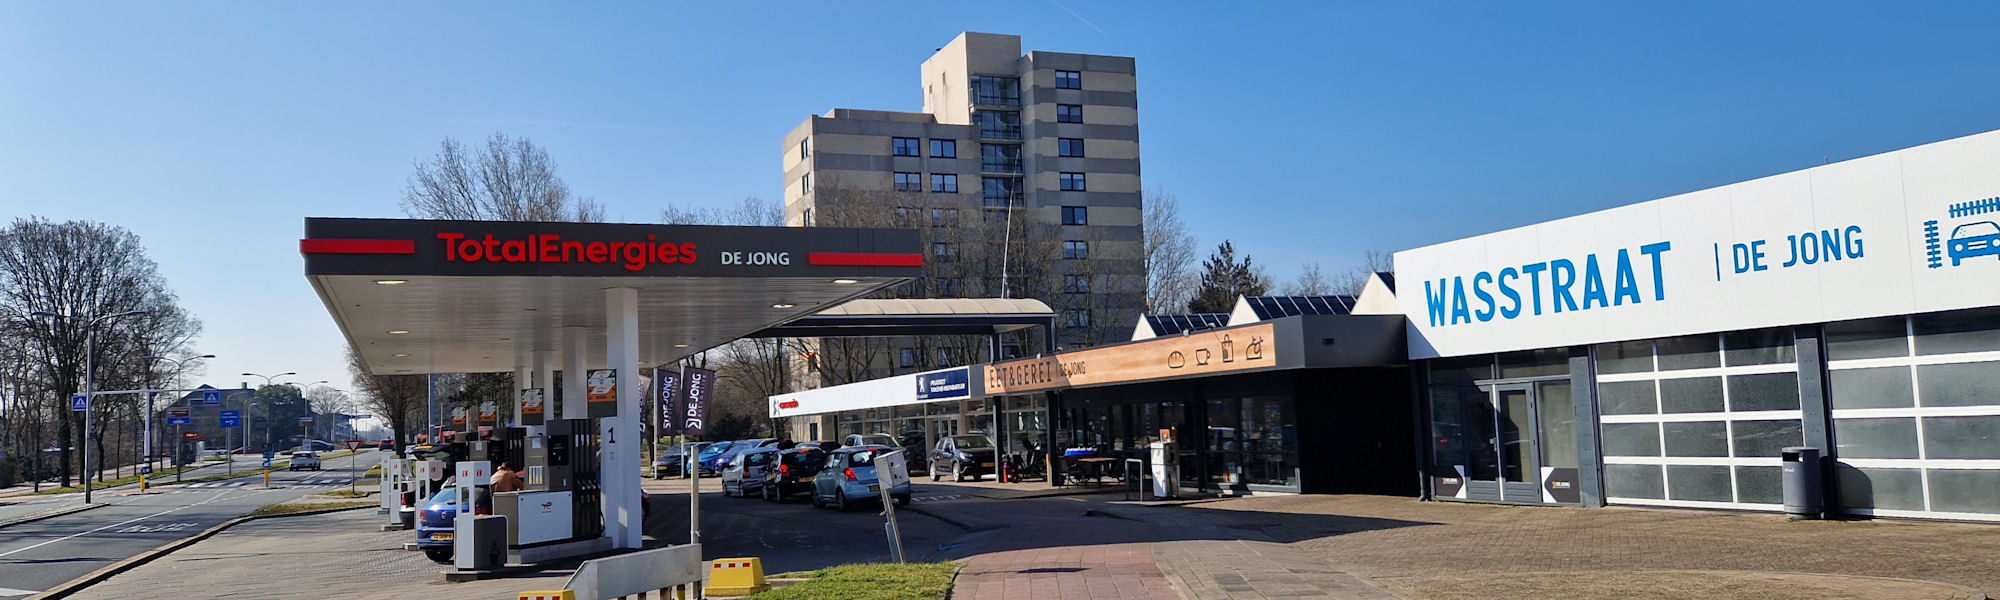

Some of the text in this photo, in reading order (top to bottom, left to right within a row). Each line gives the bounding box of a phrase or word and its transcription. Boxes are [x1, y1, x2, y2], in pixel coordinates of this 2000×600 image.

[437, 233, 697, 271] TotalEnergies
[721, 251, 790, 266] DE JONG
[1732, 225, 1864, 274] DE JONG
[1424, 241, 1671, 327] WASSTRAAT
[989, 361, 1052, 388] EET&GEREI
[1060, 361, 1086, 377] DE JONG
[687, 373, 701, 417] DE JONG
[608, 427, 616, 444] 1
